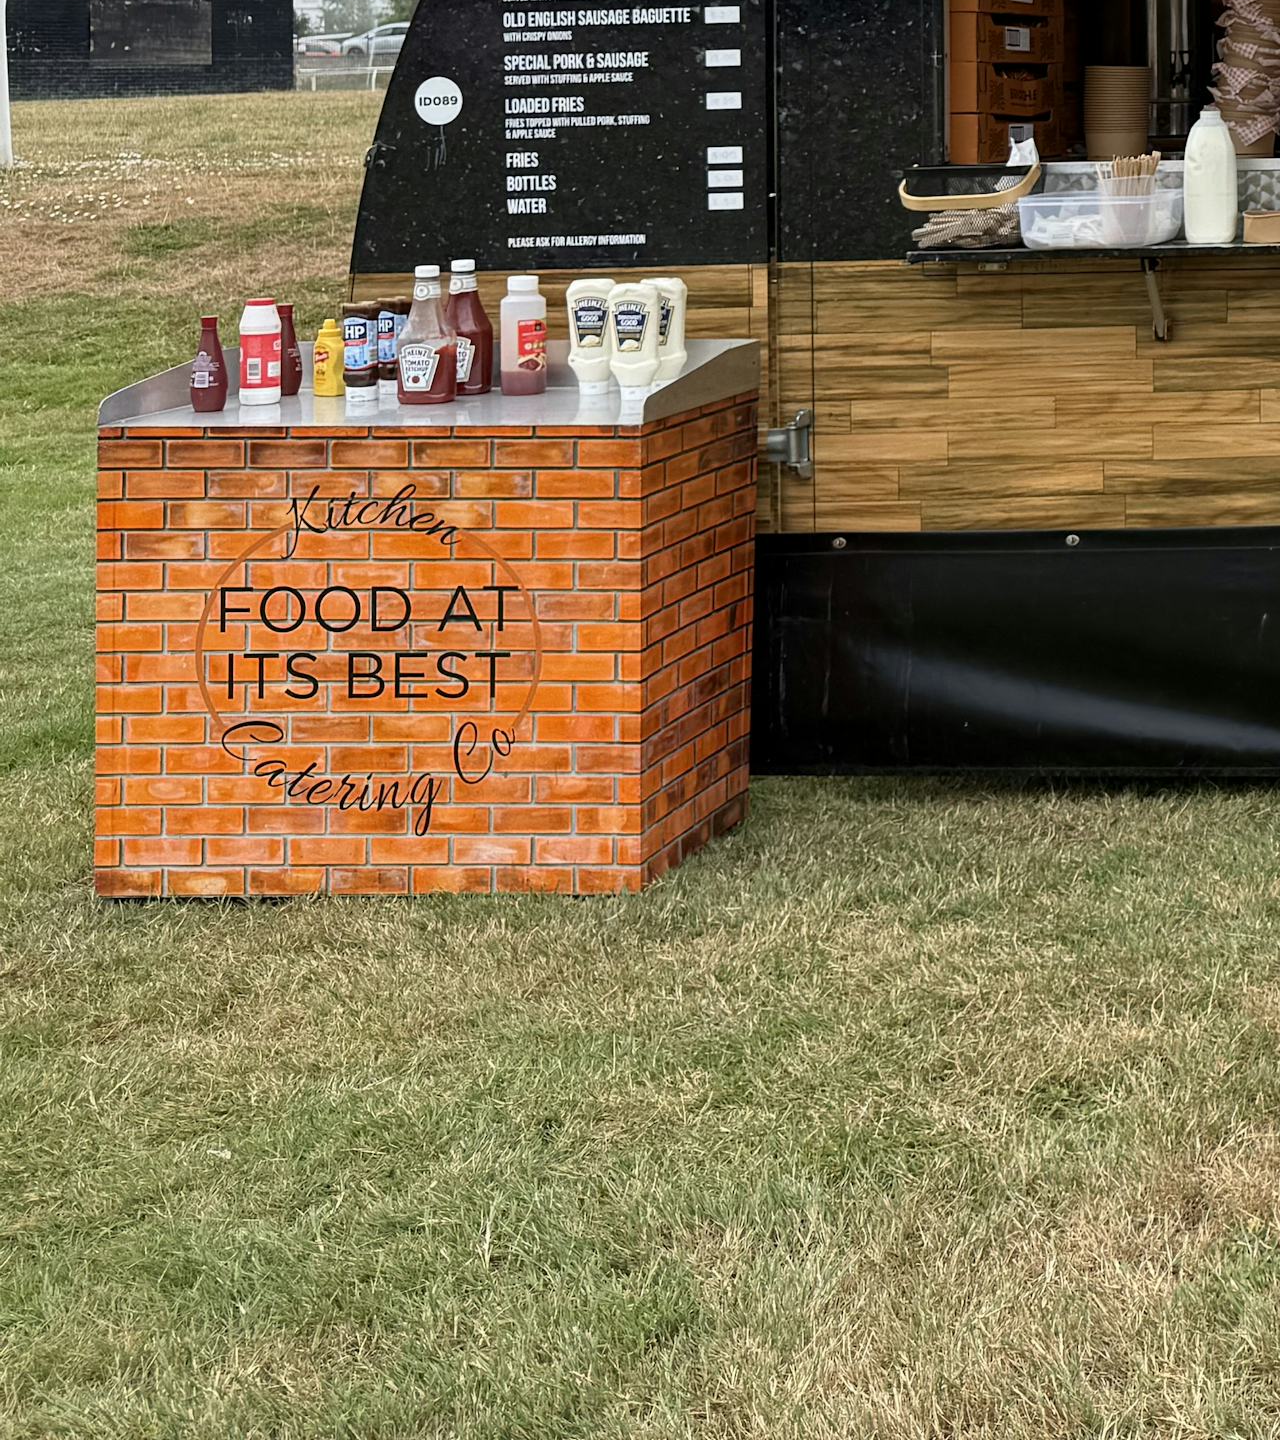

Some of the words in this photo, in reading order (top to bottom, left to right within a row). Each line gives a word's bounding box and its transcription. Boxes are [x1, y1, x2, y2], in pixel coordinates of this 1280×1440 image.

[503, 12, 525, 27] OLD
[528, 11, 576, 27] ENGLISH
[578, 9, 630, 25] SAUSAGE
[632, 7, 691, 24] BAGUETTE
[504, 55, 551, 70] SPECIAL
[553, 54, 584, 69] PORK
[586, 53, 595, 68] &
[596, 52, 649, 68] SAUSAGE
[505, 98, 550, 113] LOADED
[552, 97, 584, 112] FRIES
[506, 152, 538, 168] FRIES
[507, 175, 556, 191] BOTTLES
[507, 198, 546, 214] WATER
[508, 237, 535, 248] PLEASE
[536, 237, 550, 247] ASK
[551, 236, 565, 246] FOR
[566, 236, 597, 246] ALLERGY
[598, 234, 646, 245] INFORMATION
[344, 326, 365, 339] HP
[378, 320, 392, 333] HP
[281, 483, 461, 558] Kitchen
[219, 586, 411, 633] FOOD
[438, 585, 518, 631] AT
[226, 652, 318, 699] ITS
[347, 652, 510, 699] BEST
[221, 720, 442, 836] Catering
[453, 721, 516, 784] Co
